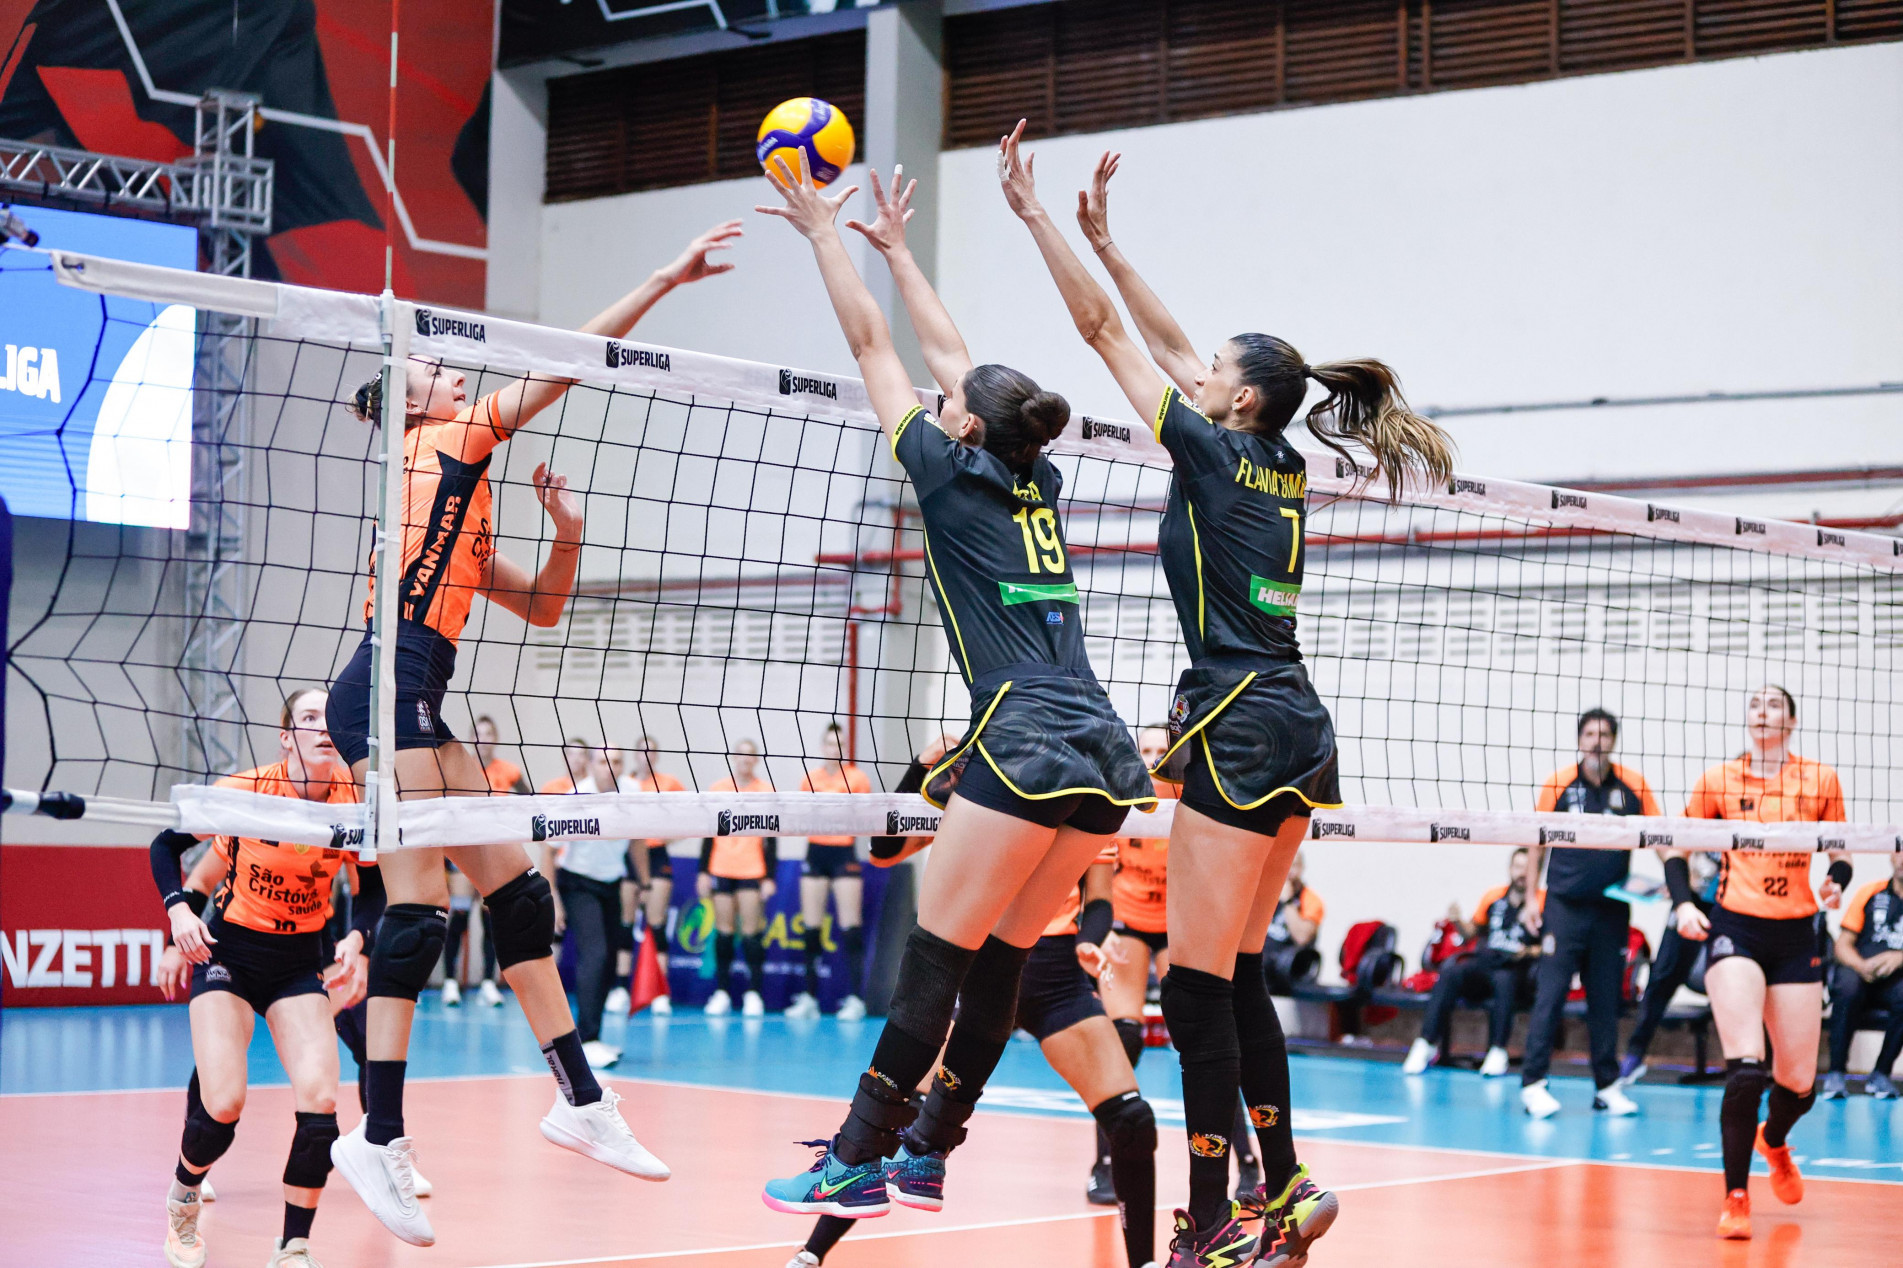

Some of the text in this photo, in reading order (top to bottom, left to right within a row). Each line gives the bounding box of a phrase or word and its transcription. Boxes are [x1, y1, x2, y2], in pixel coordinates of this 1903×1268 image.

[432, 316, 486, 343] SUPERLIGA
[621, 348, 671, 372] SUPERLIGA
[792, 376, 837, 401] SUPERLIGA
[1093, 422, 1131, 444] SUPERLIGA
[1235, 456, 1279, 496] FLAVIA
[1456, 479, 1487, 496] SUPERLIGA
[1559, 494, 1588, 510] SUPERLIGA
[410, 495, 462, 598] YANMAR
[1013, 507, 1065, 574] 19
[1279, 507, 1300, 573] 7
[548, 818, 600, 838] SUPERLIGA
[732, 814, 780, 833] SUPERLIGA
[900, 816, 942, 832] SUPERLIG
[1321, 823, 1355, 838] SUPERLIGA
[1439, 827, 1470, 841] SUPERLIGA
[250, 863, 284, 886] São
[1763, 877, 1788, 897] 22
